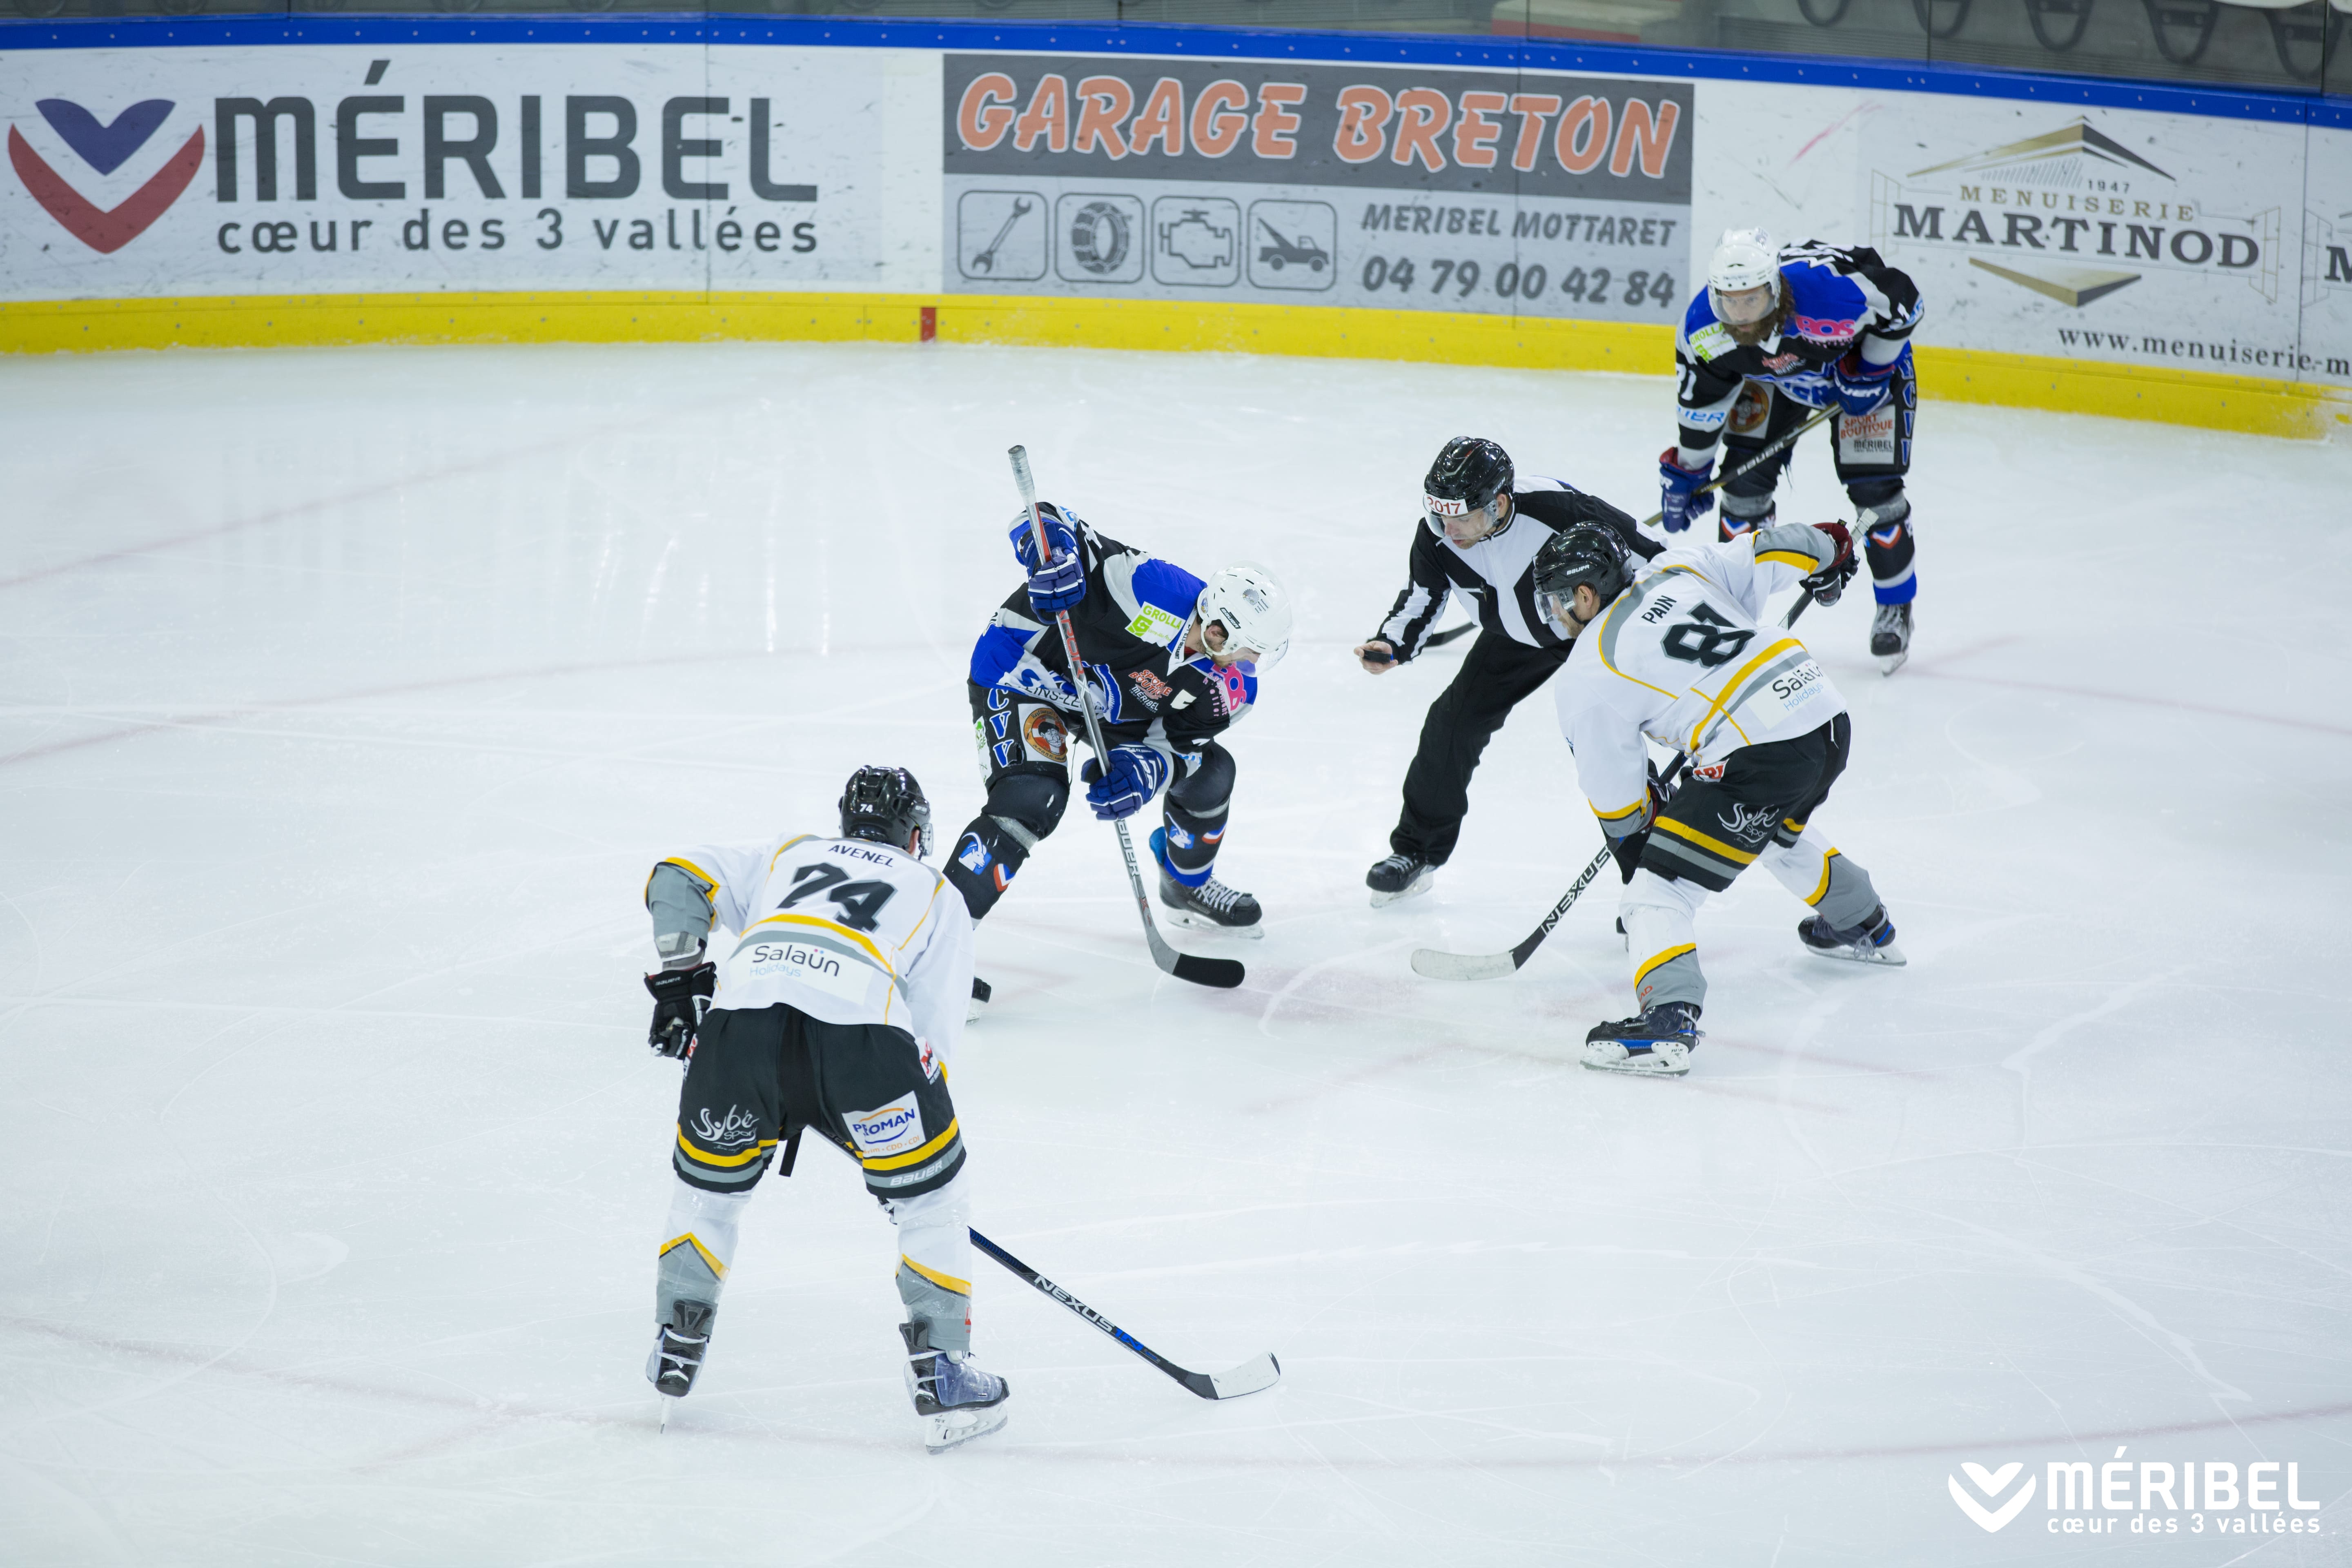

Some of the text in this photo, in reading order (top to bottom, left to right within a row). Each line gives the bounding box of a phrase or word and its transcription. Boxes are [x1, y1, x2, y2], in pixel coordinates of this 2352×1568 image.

[215, 60, 817, 202] MÉRIBEL
[956, 71, 1681, 179] GARAGE BRETON
[2088, 178, 2130, 194] 1947
[1961, 185, 2194, 223] MENUISERIE
[218, 207, 816, 254] cœur des 3 vallées
[1362, 204, 1500, 236] MERIBEL
[1512, 212, 1677, 246] MOTTARET
[1894, 205, 2259, 268] MARTINOD
[1363, 256, 1675, 308] 04 79 00 42 84
[1690, 322, 1725, 345] GROLLA
[1795, 314, 1855, 338] BOS
[1840, 420, 1893, 439] BOUTIQUE
[1844, 414, 1878, 428] SPORT
[1737, 441, 1784, 476] BAUER
[1427, 497, 1461, 514] 2017
[1566, 564, 1590, 575] BAUER
[1143, 605, 1182, 630] GROLLA
[1220, 608, 1240, 628] BAUER
[1641, 595, 1677, 624] PAIN
[1660, 599, 1757, 669] 81
[1139, 669, 1166, 688] SPOR
[1783, 683, 1824, 711] Holidays
[859, 803, 874, 813] 74
[828, 845, 894, 867] AVENEL
[1117, 820, 1140, 877] AUER
[775, 862, 898, 933] 74
[1540, 845, 1612, 936] NEXUS
[750, 962, 802, 977] Holidays
[752, 944, 840, 977] Salaün
[655, 976, 681, 986] BAUER
[886, 1143, 903, 1152] CDD
[909, 1136, 920, 1145] CDI
[890, 1160, 943, 1186] BAUER
[1034, 1275, 1115, 1333] NEXUS
